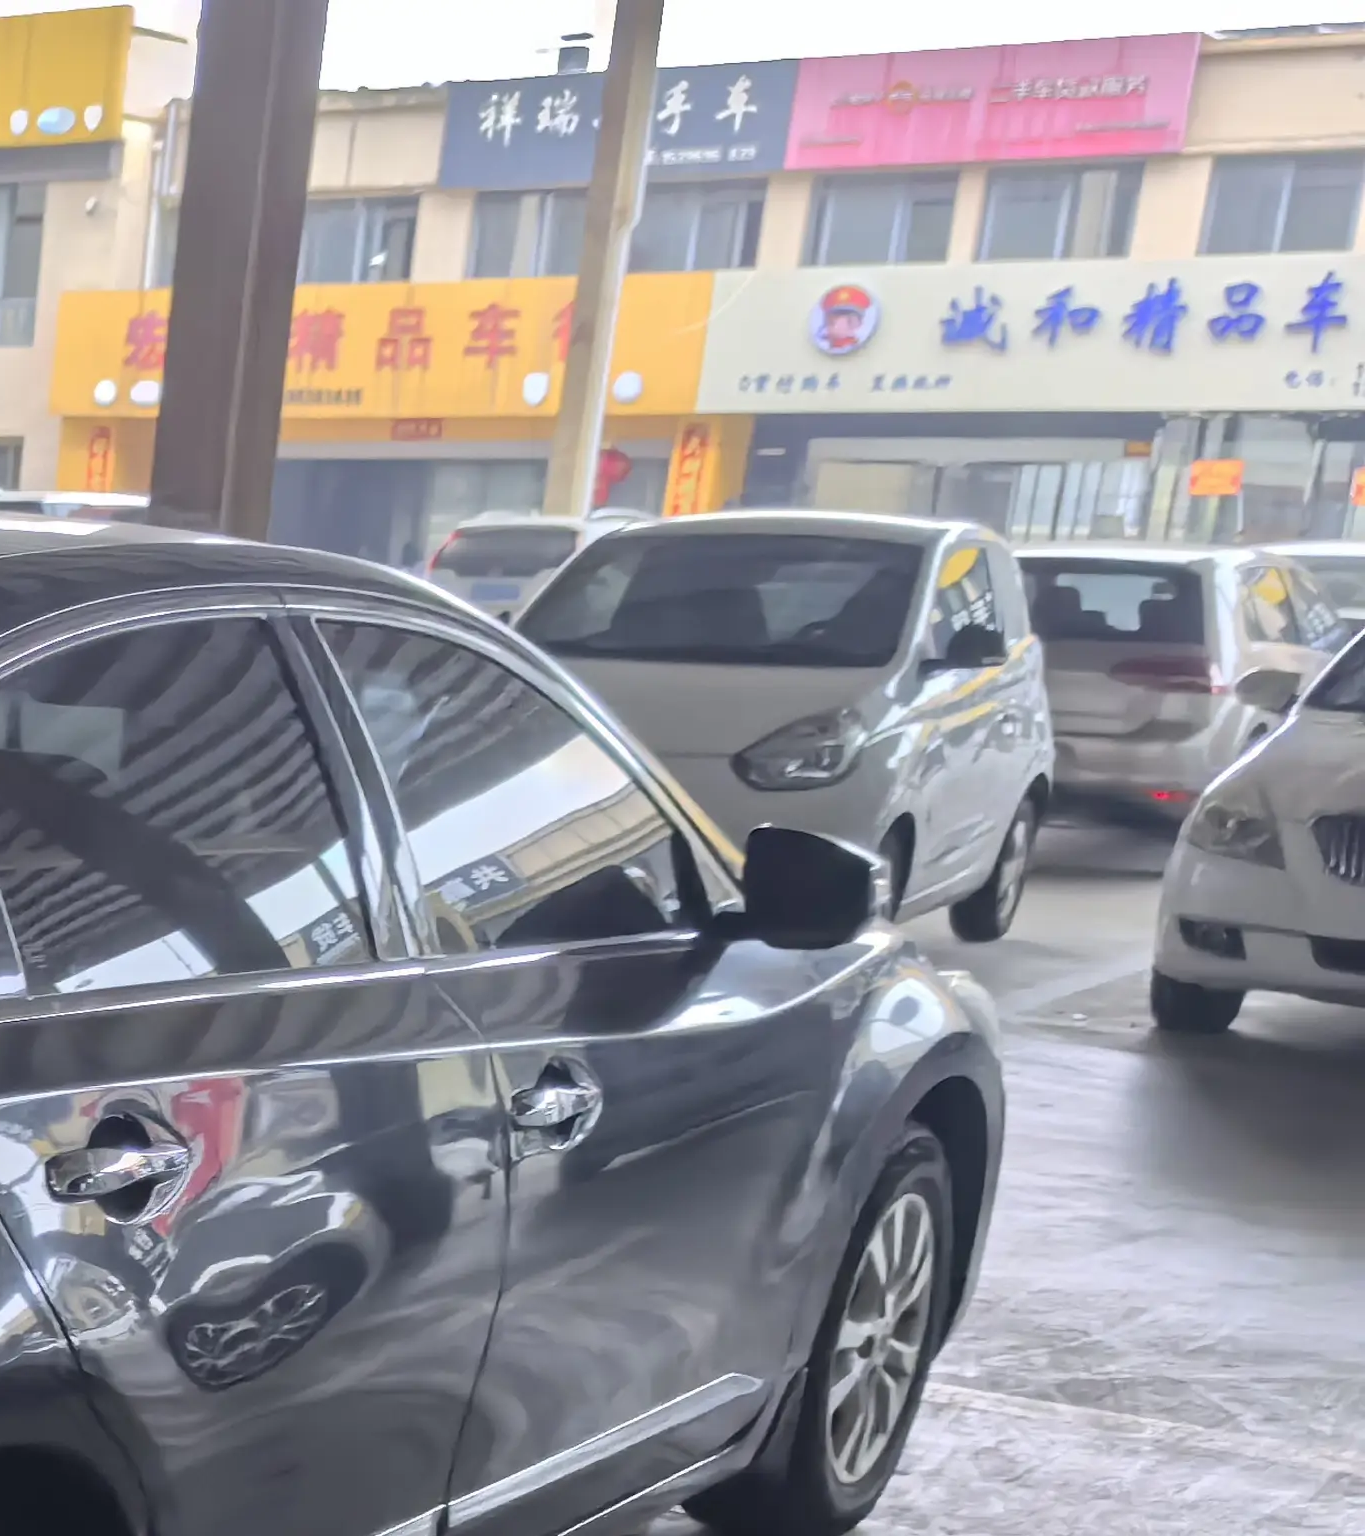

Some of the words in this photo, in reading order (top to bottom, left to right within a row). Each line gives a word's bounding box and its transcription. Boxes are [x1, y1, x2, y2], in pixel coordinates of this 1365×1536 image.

[479, 74, 758, 147] 祥瑞手车
[940, 271, 1348, 354] 诚和精品车
